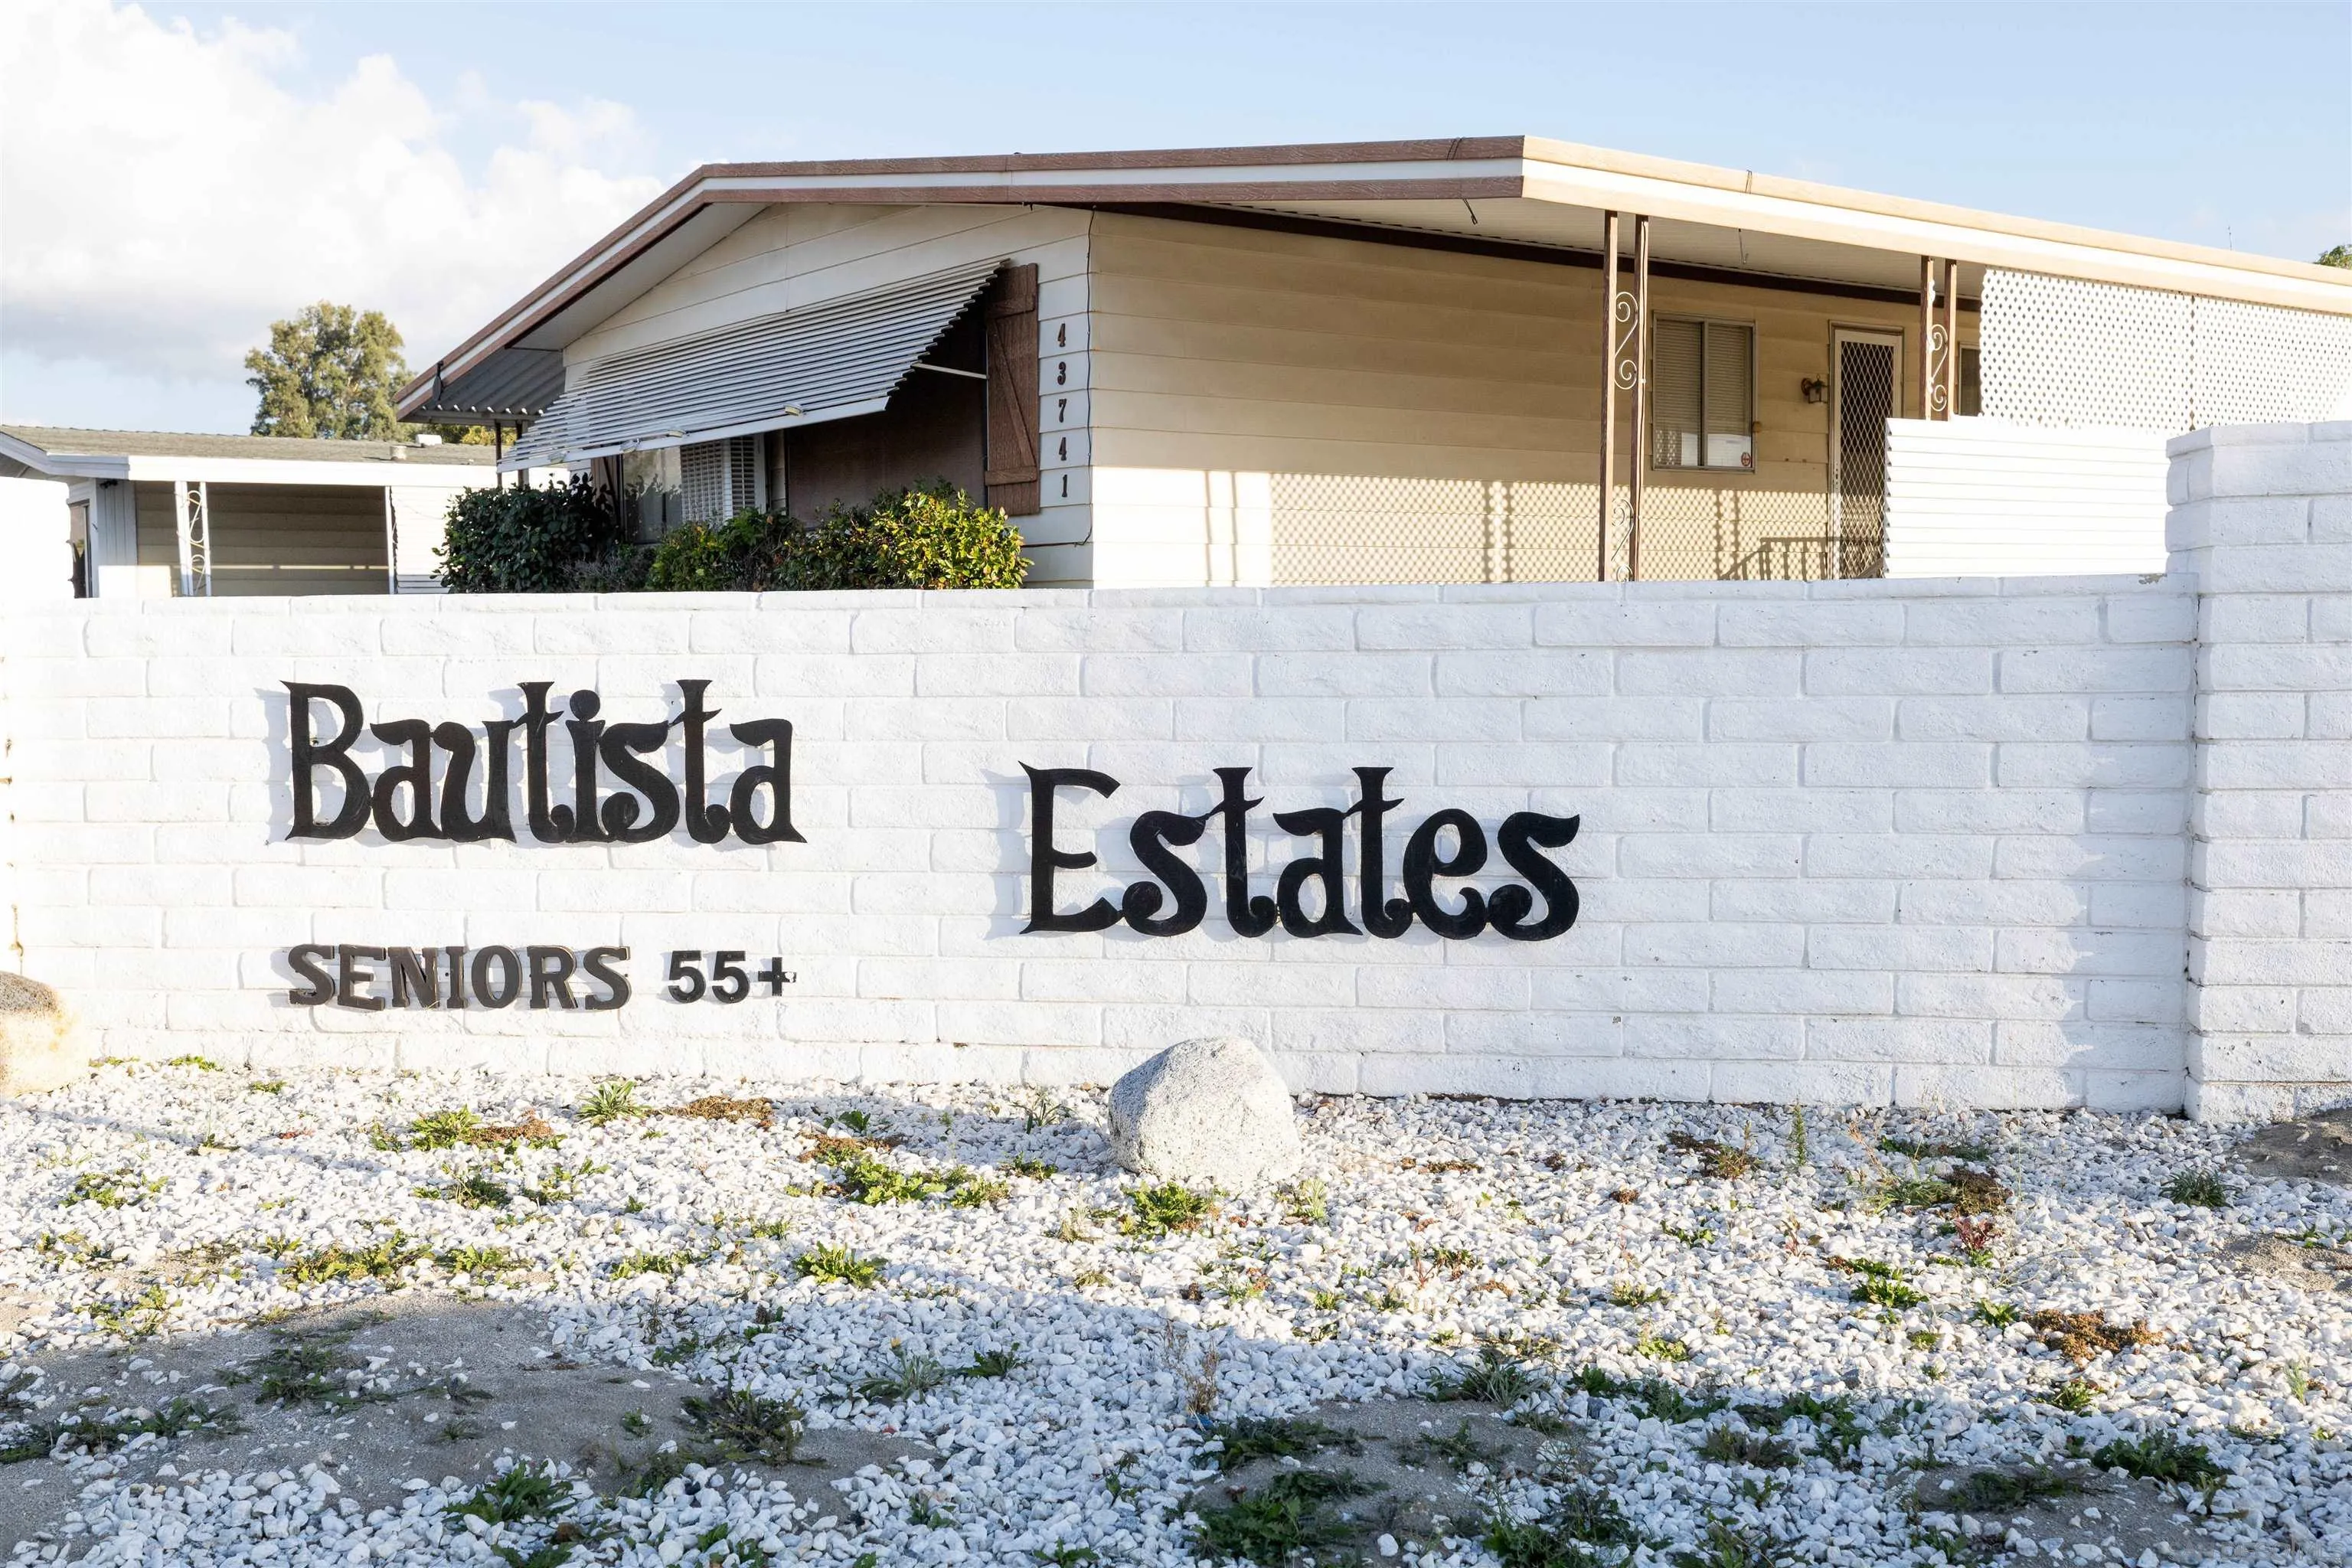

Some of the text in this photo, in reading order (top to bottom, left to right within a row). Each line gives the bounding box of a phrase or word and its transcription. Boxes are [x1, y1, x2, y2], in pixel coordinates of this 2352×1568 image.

[280, 679, 808, 844] Bautista
[1018, 760, 1580, 940] Estates
[288, 943, 798, 1011] SENIORS 55+
